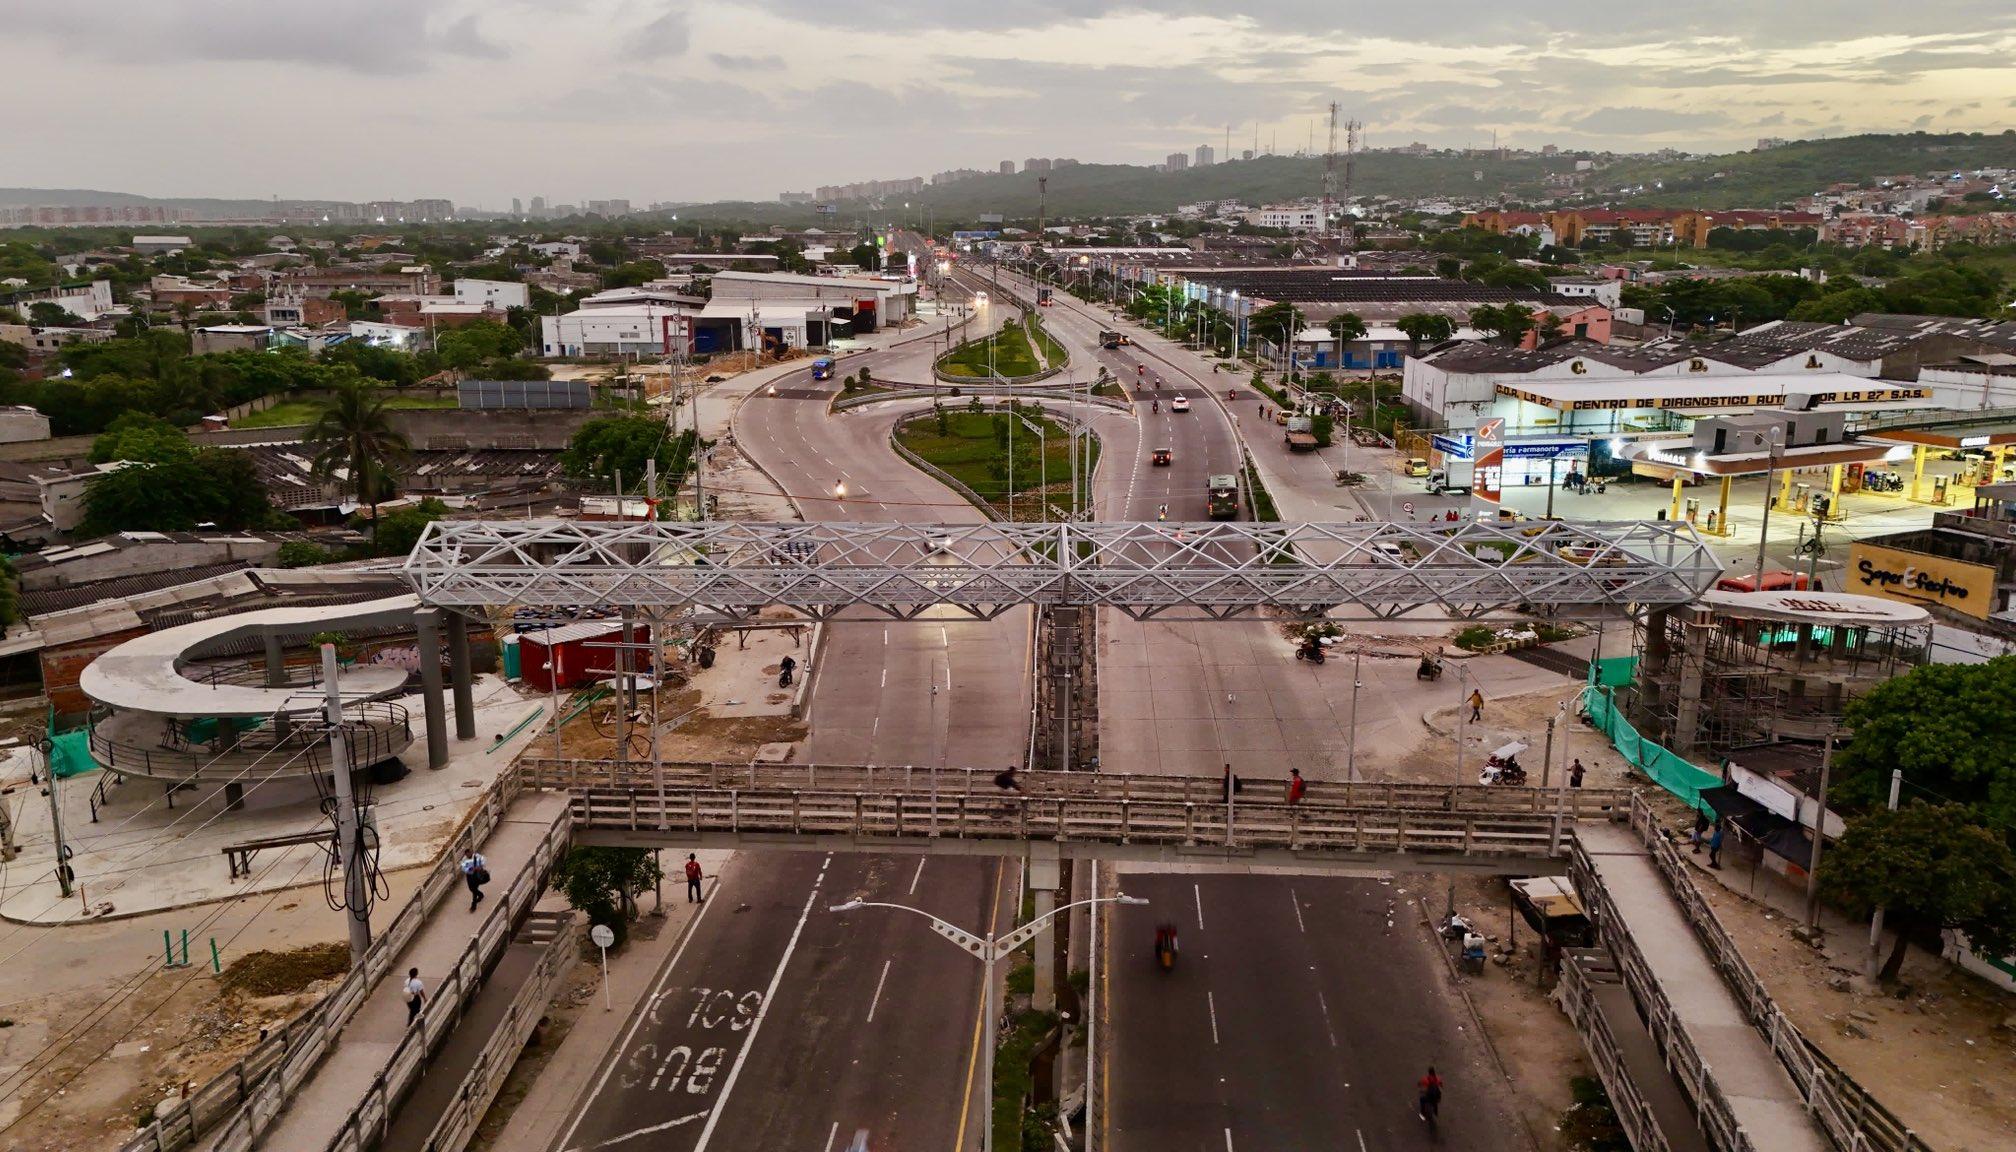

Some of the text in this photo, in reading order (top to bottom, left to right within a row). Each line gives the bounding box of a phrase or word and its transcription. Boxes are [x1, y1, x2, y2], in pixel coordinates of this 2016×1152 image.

[1571, 354, 1823, 374] C. D. A.
[1524, 392, 1537, 403] LA
[1540, 396, 1553, 407] 27
[1573, 399, 1628, 410] CENTRO
[1636, 398, 1654, 408] DE
[1661, 395, 1749, 408] DIAGNOSTICO
[1843, 391, 1860, 401] LA
[1867, 390, 1884, 400] 27
[1890, 389, 1925, 399] S.A.S.
